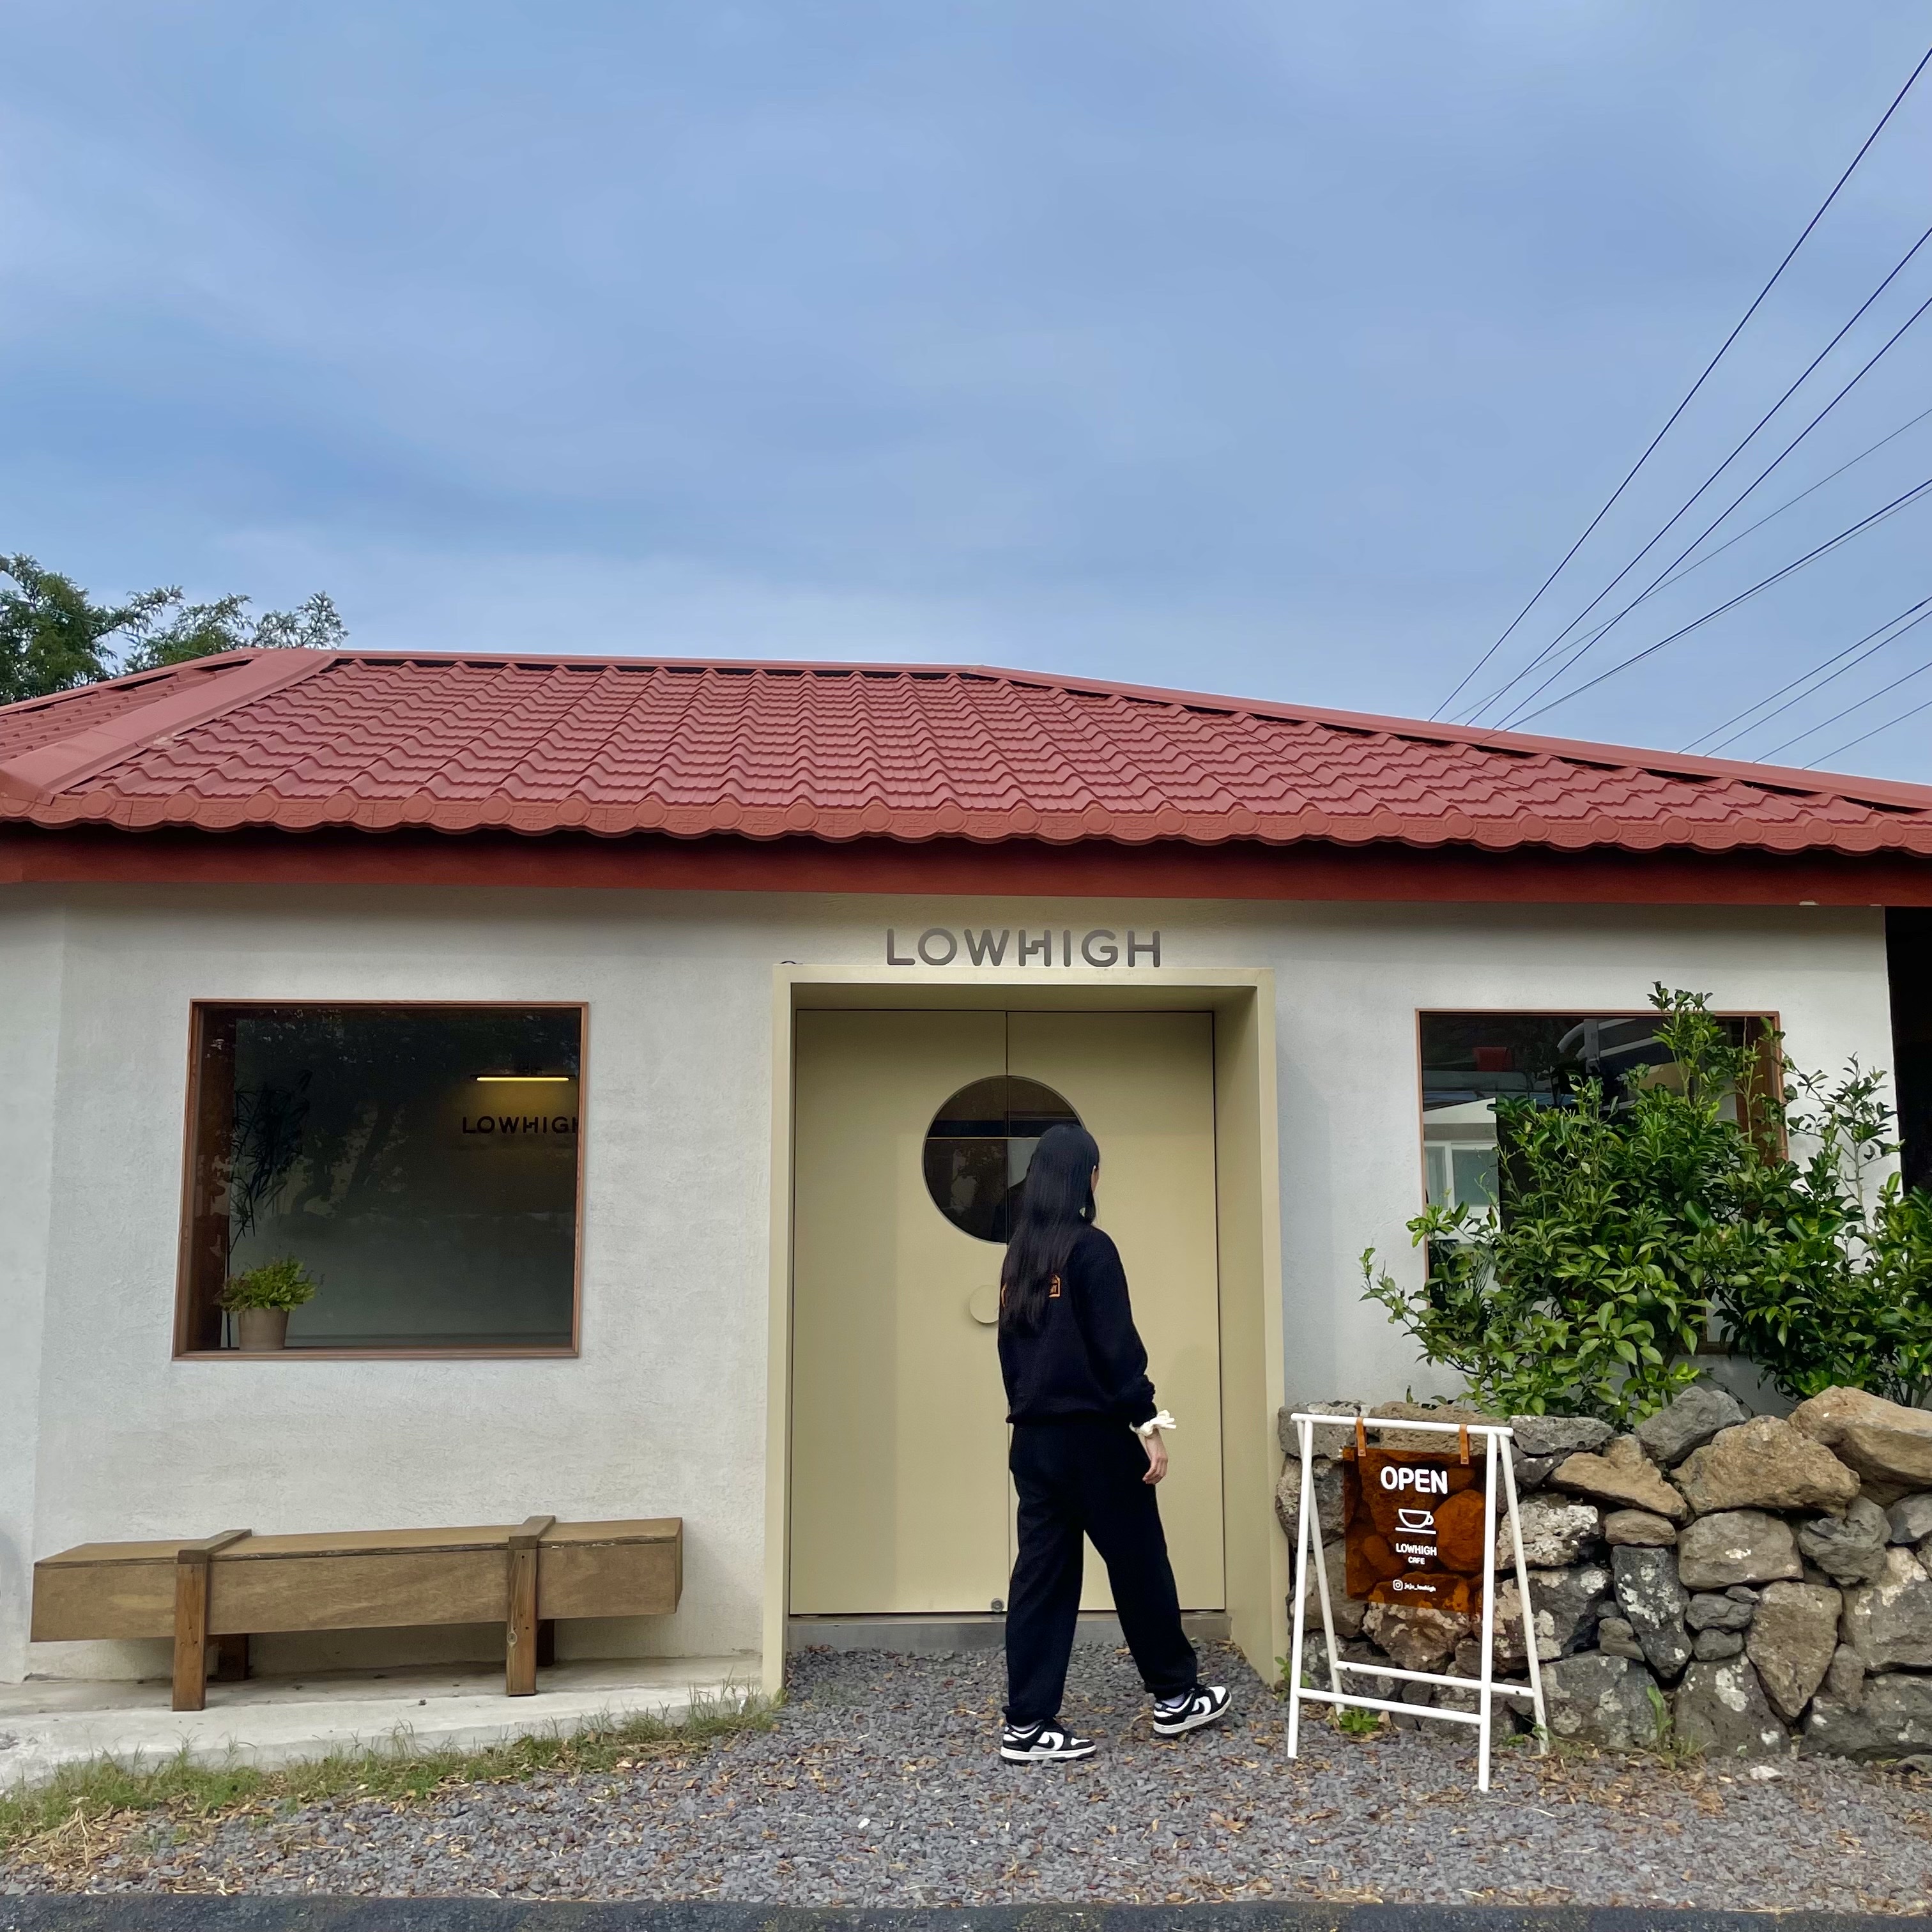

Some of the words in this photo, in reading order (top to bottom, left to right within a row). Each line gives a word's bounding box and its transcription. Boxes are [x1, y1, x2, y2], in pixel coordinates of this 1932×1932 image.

[887, 928, 1161, 967] LOWHIGH
[1381, 1466, 1448, 1494] OPEN
[1395, 1542, 1437, 1556] LOWHIGH
[1407, 1556, 1425, 1565] CAFE
